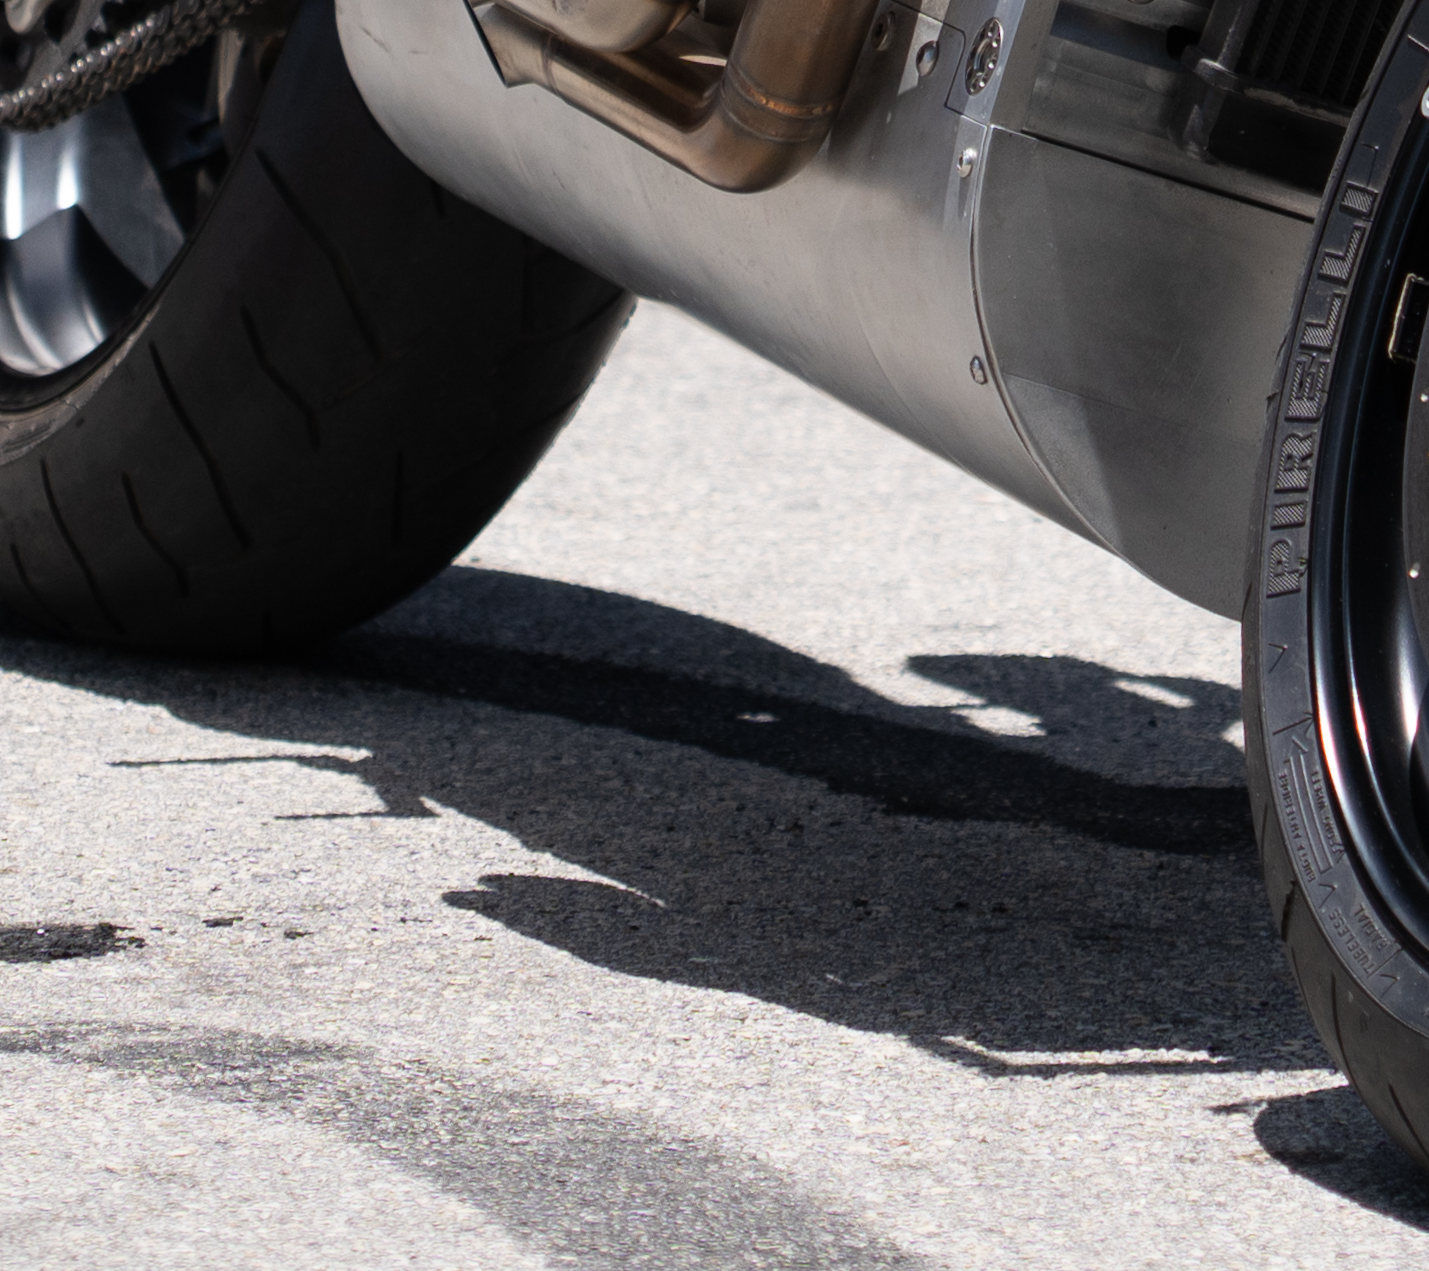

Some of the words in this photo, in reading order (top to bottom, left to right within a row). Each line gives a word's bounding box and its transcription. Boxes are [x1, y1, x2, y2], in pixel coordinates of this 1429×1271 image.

[1265, 183, 1379, 599] PIRELLI
[1328, 908, 1375, 978] TUBELESS
[1350, 904, 1388, 951] RADIAL
